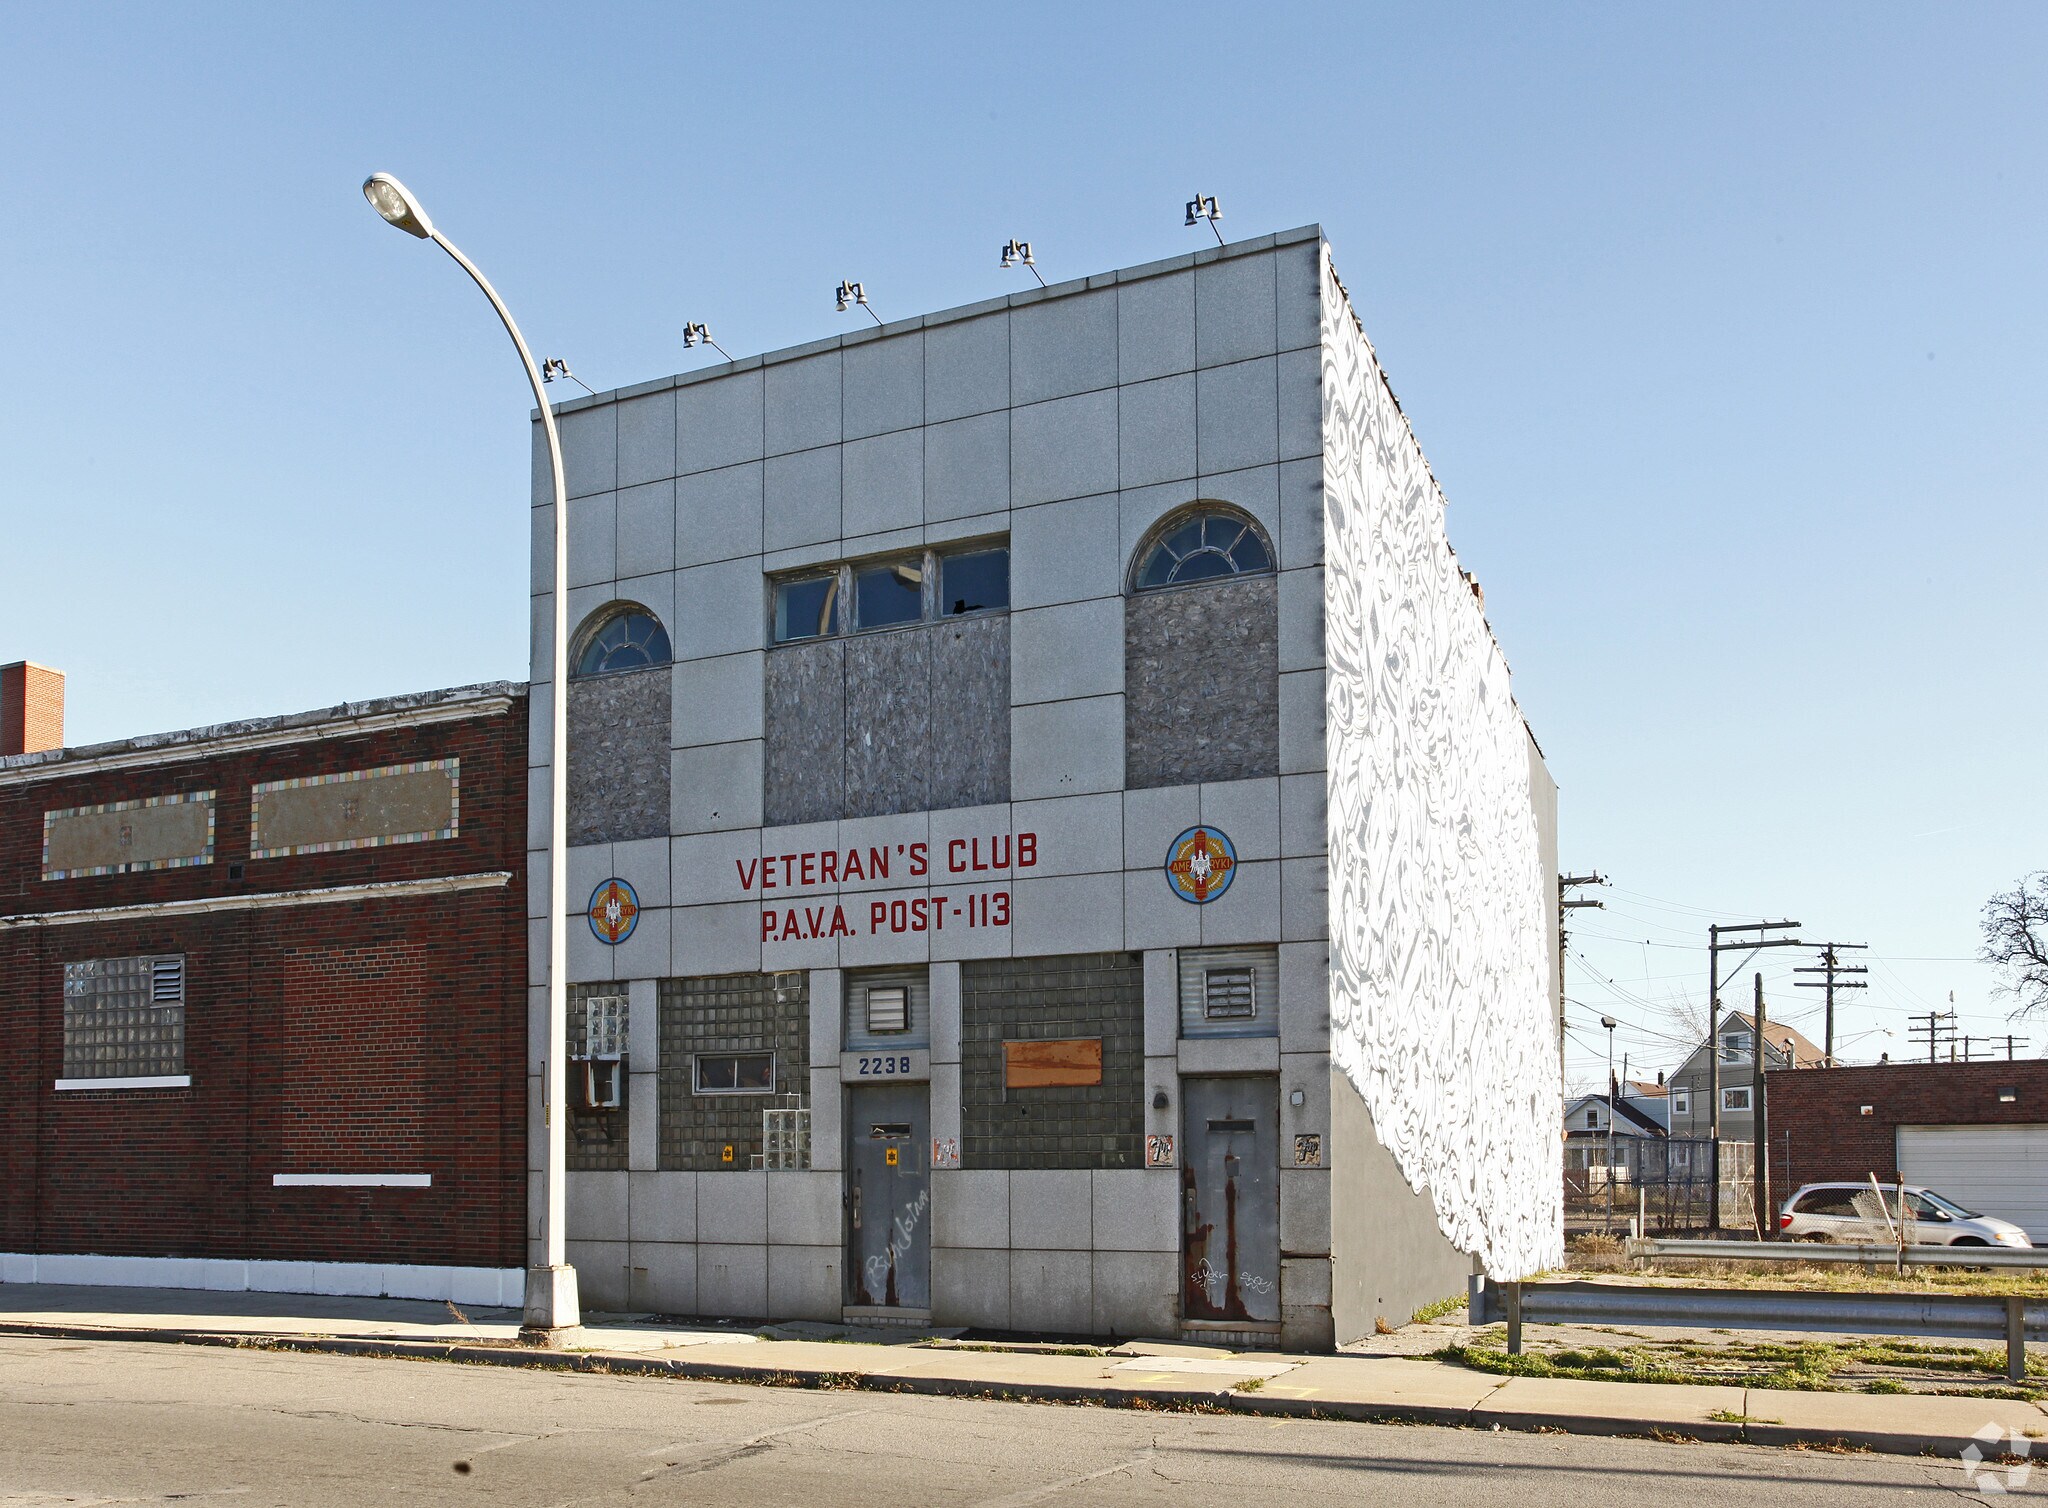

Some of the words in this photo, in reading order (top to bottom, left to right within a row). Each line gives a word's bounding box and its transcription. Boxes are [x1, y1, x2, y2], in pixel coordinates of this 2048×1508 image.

[736, 843, 928, 890] VETERAN'S
[948, 833, 1037, 873] CLUB
[762, 905, 856, 942] P.A.V.A.
[859, 1056, 910, 1075] 2238
